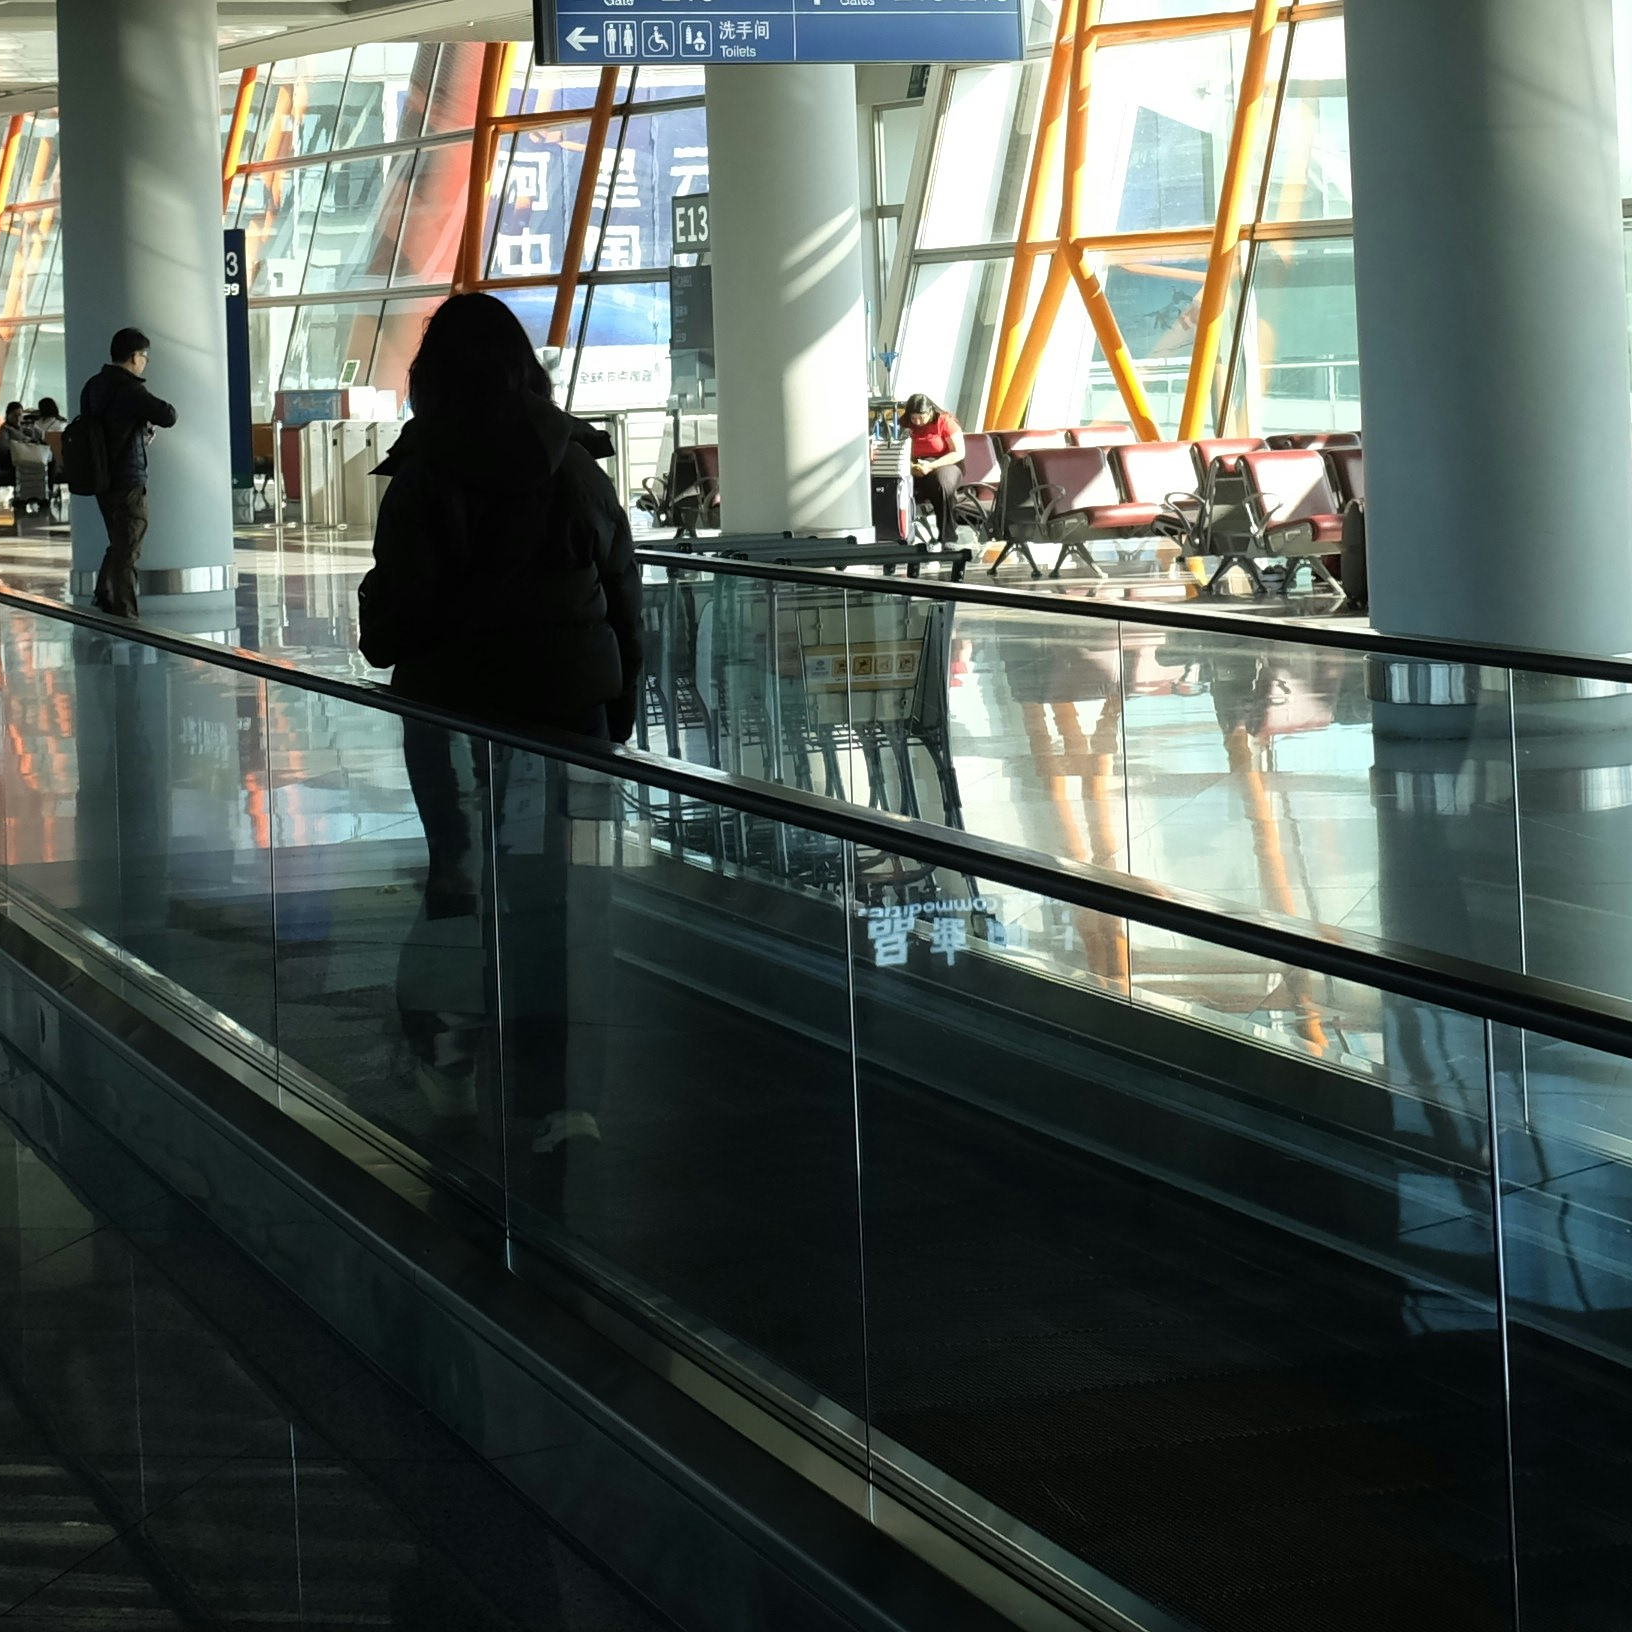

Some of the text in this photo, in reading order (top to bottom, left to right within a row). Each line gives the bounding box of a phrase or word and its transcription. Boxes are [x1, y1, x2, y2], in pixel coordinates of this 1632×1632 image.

[719, 20, 770, 40] 洗手间
[720, 45, 756, 58] Toilets
[675, 205, 709, 243] E13
[226, 251, 239, 277] 3
